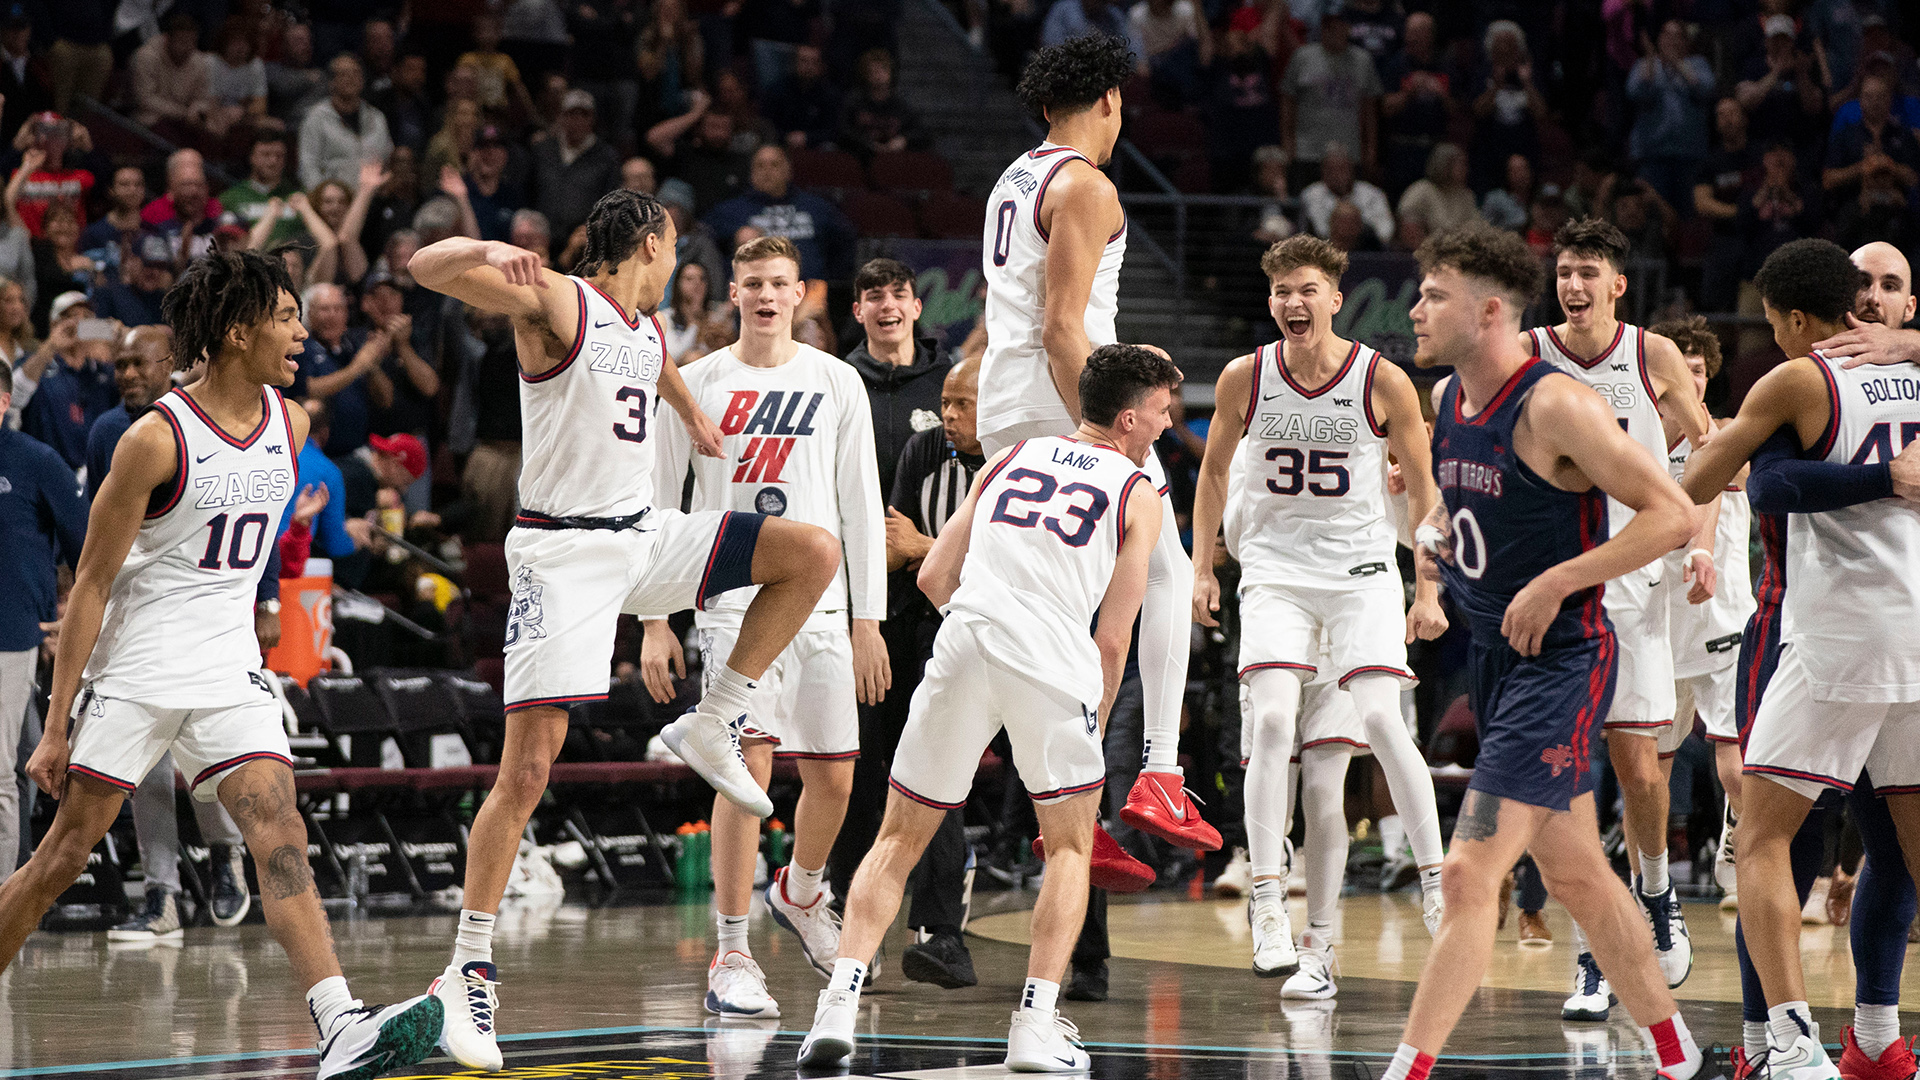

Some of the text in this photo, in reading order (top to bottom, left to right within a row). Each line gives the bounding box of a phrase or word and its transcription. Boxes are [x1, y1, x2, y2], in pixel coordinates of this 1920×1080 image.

[992, 200, 1018, 267] 0
[612, 385, 648, 444] 3
[719, 390, 826, 437] BALL
[1333, 397, 1354, 408] WCC
[1591, 383, 1637, 409] GS
[1260, 413, 1359, 445] ZAGS
[731, 436, 798, 484] IN
[1051, 447, 1100, 471] LANG
[1264, 447, 1351, 498] 35
[195, 468, 290, 510] ZAGS
[989, 467, 1110, 549] 23
[198, 513, 270, 571] 10
[1452, 506, 1487, 580] 0
